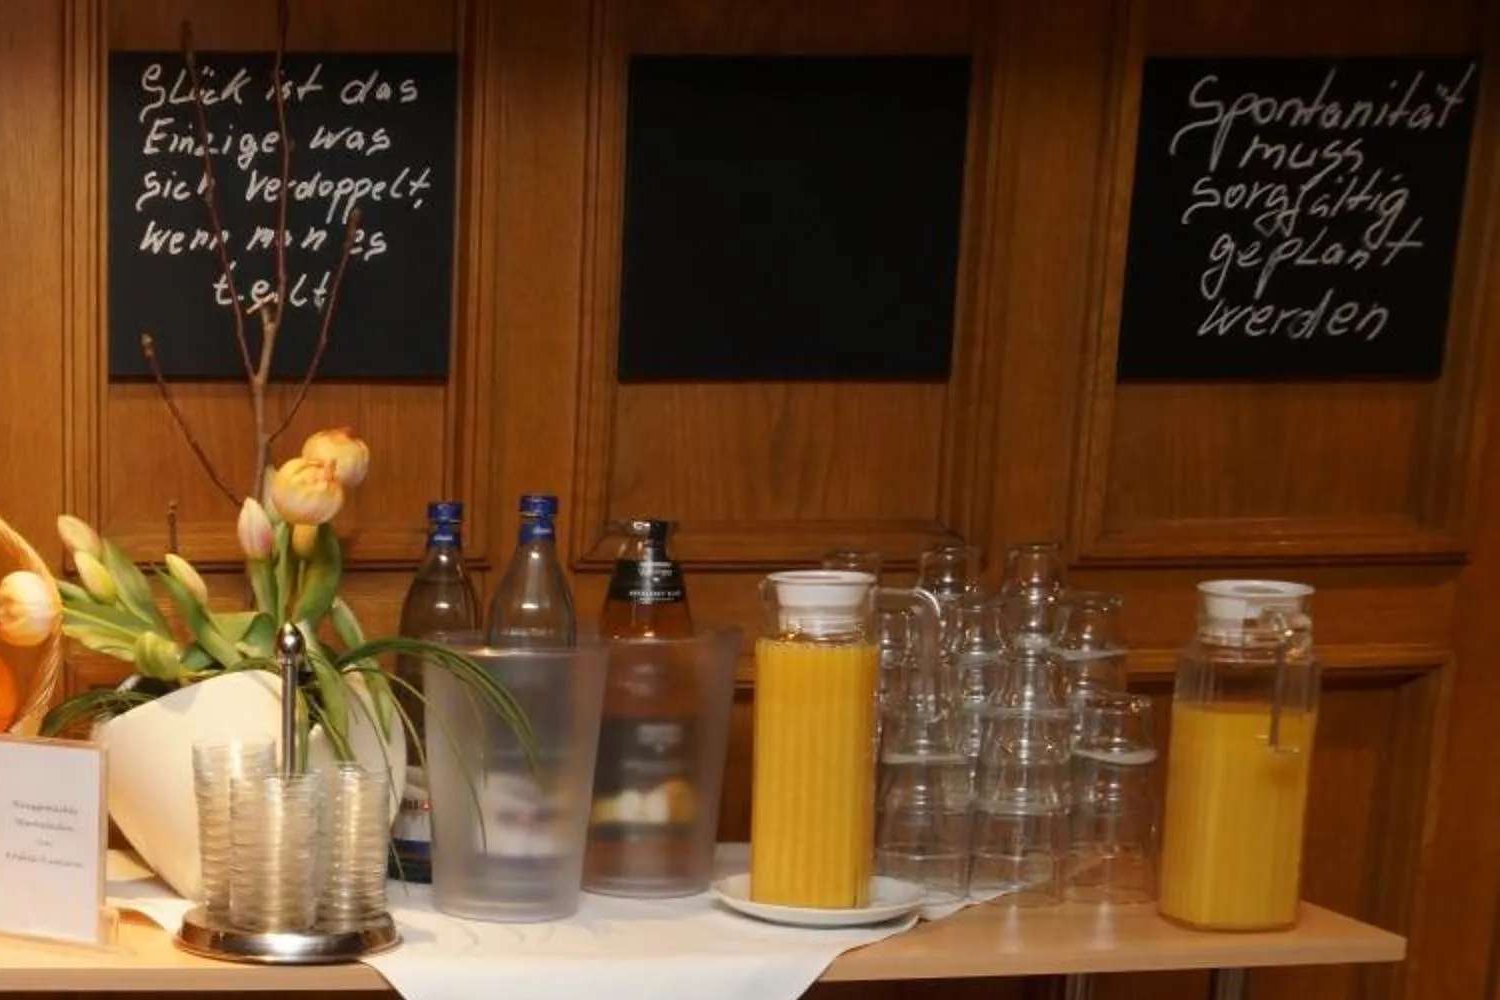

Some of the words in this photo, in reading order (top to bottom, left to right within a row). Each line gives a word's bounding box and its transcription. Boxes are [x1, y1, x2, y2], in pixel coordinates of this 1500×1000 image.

[265, 64, 324, 102] ist
[340, 69, 419, 104] das
[308, 125, 391, 156] was
[1238, 134, 1364, 172] muss
[213, 260, 331, 308] telt
